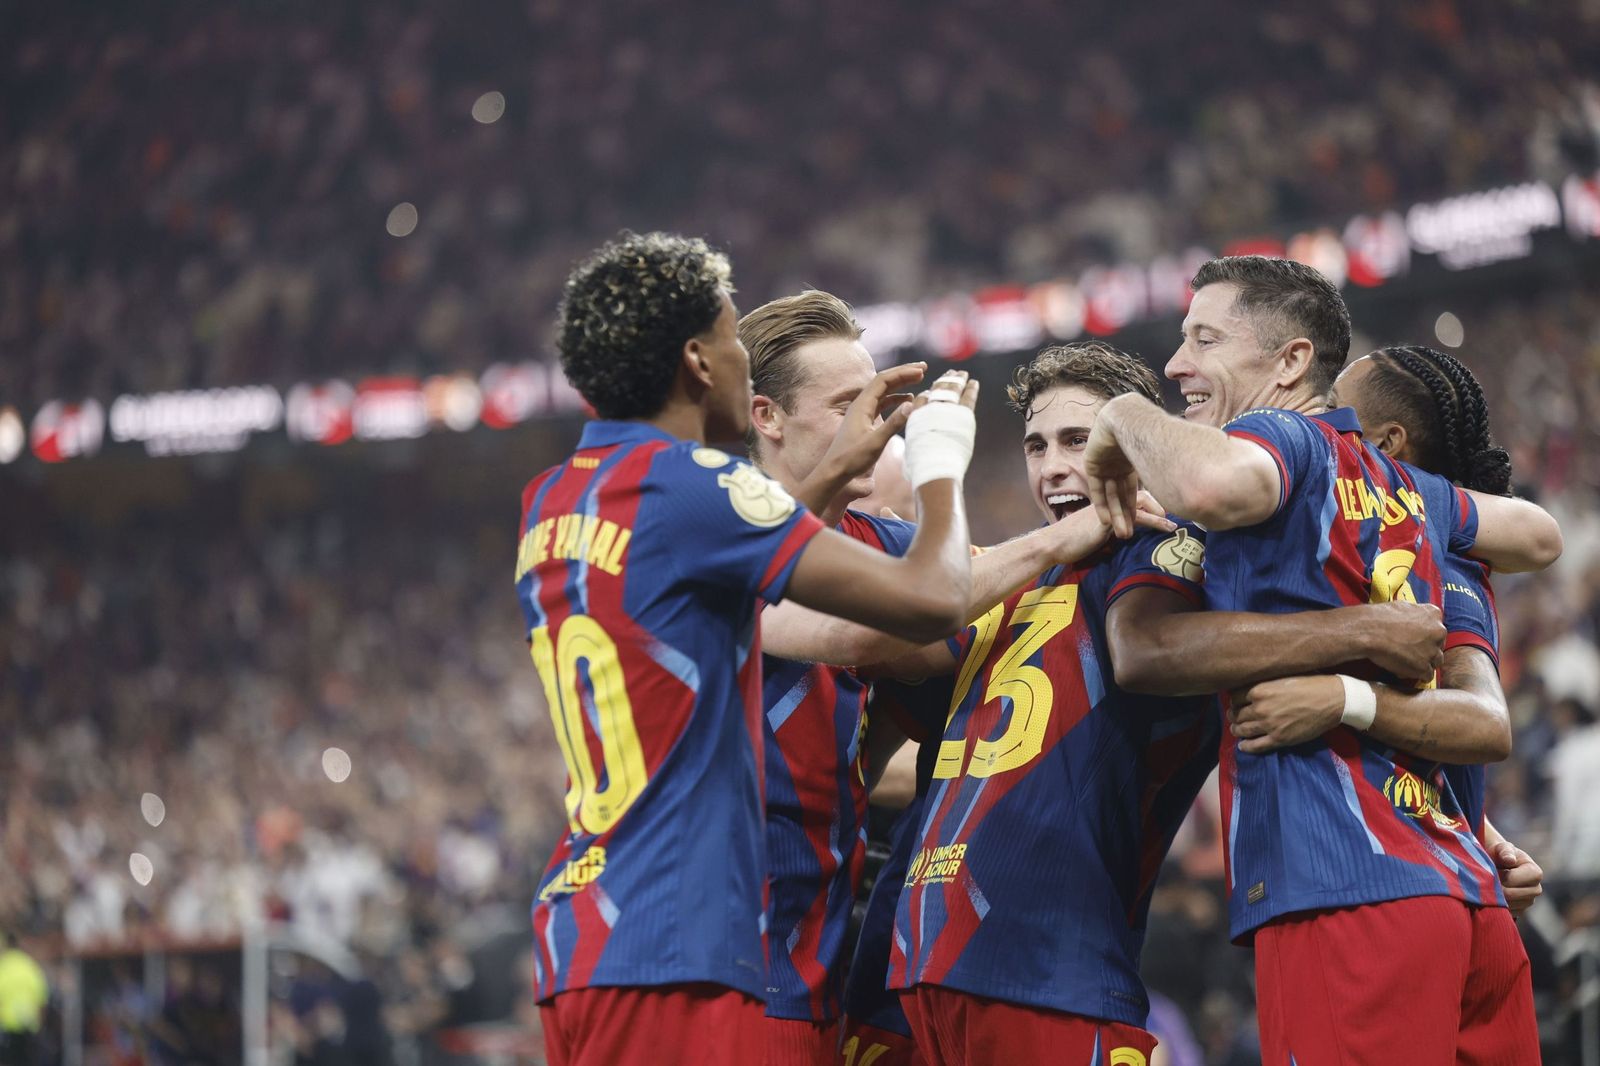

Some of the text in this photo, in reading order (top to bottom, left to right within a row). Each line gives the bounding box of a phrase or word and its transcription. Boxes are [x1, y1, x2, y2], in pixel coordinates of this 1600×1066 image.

[530, 614, 648, 835] 10
[931, 583, 1079, 780] 23
[922, 860, 961, 878] ACNUR
[930, 844, 967, 862] UNHCR
